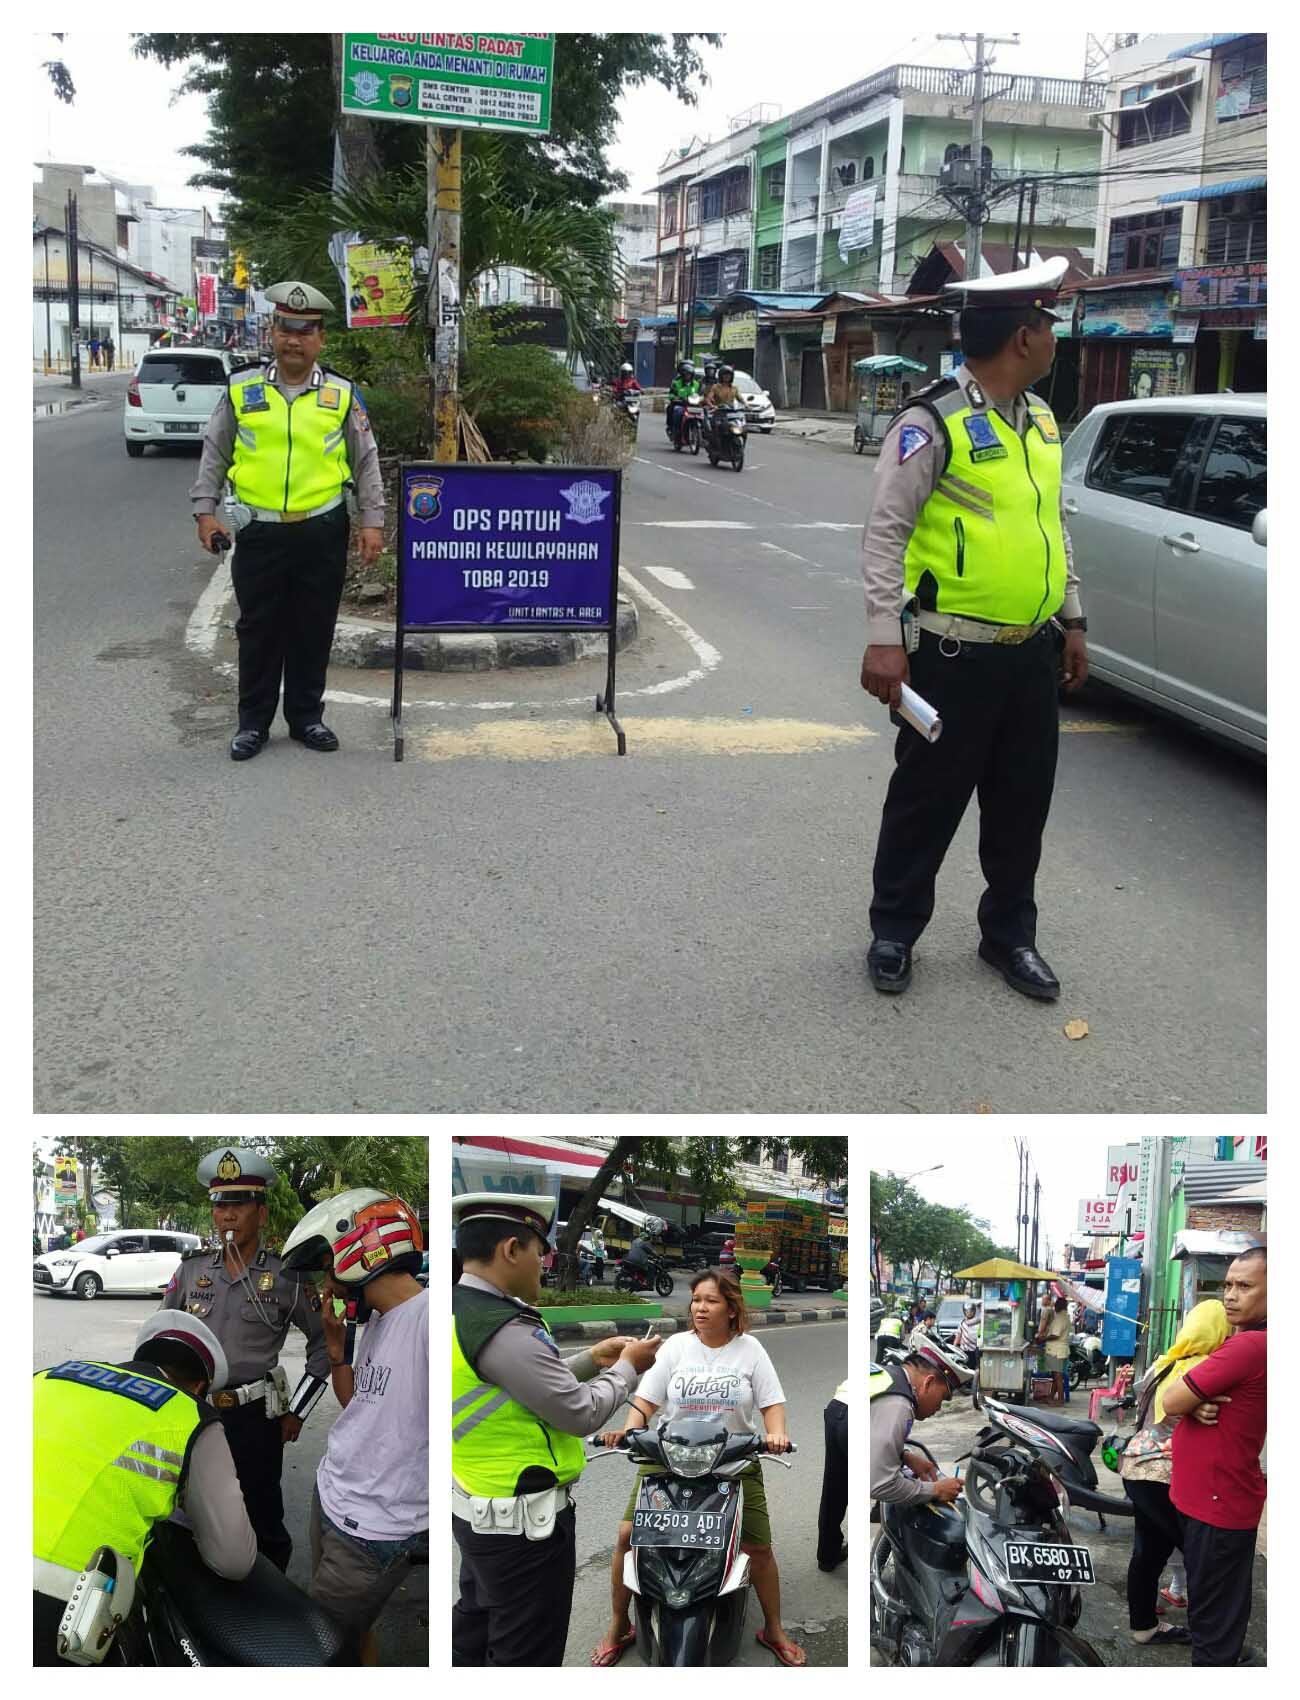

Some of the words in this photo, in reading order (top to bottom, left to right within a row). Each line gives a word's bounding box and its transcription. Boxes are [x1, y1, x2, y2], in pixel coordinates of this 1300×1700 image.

[422, 33, 473, 50] LINTAS
[479, 36, 523, 56] PADAT
[352, 44, 410, 65] KELUARGA
[413, 52, 442, 69] ANDA
[446, 56, 492, 76] MENANTI
[496, 63, 506, 77] DI
[509, 64, 546, 82] RUMAH
[422, 82, 438, 90] SMS
[440, 84, 469, 93] CENTER
[422, 92, 440, 100] CALL
[443, 94, 472, 103] CENTER
[436, 103, 464, 112] CENTER
[453, 509, 491, 531] OPS
[498, 509, 561, 531] PATUH
[412, 541, 481, 559] MANDIRI
[486, 542, 599, 560] KEWILAYAHAN
[462, 569, 503, 588] TOBA
[508, 570, 549, 588] 2019
[508, 607, 528, 617] UNIT
[531, 607, 564, 617] LANTAS
[579, 607, 602, 617] AREA
[55, 1362, 169, 1400] POLISI
[675, 1375, 741, 1398] Vintage
[697, 1515, 722, 1529] ADT
[1009, 1546, 1032, 1564] BK
[1034, 1547, 1069, 1566] 6580
[1073, 1549, 1087, 1567] IT
